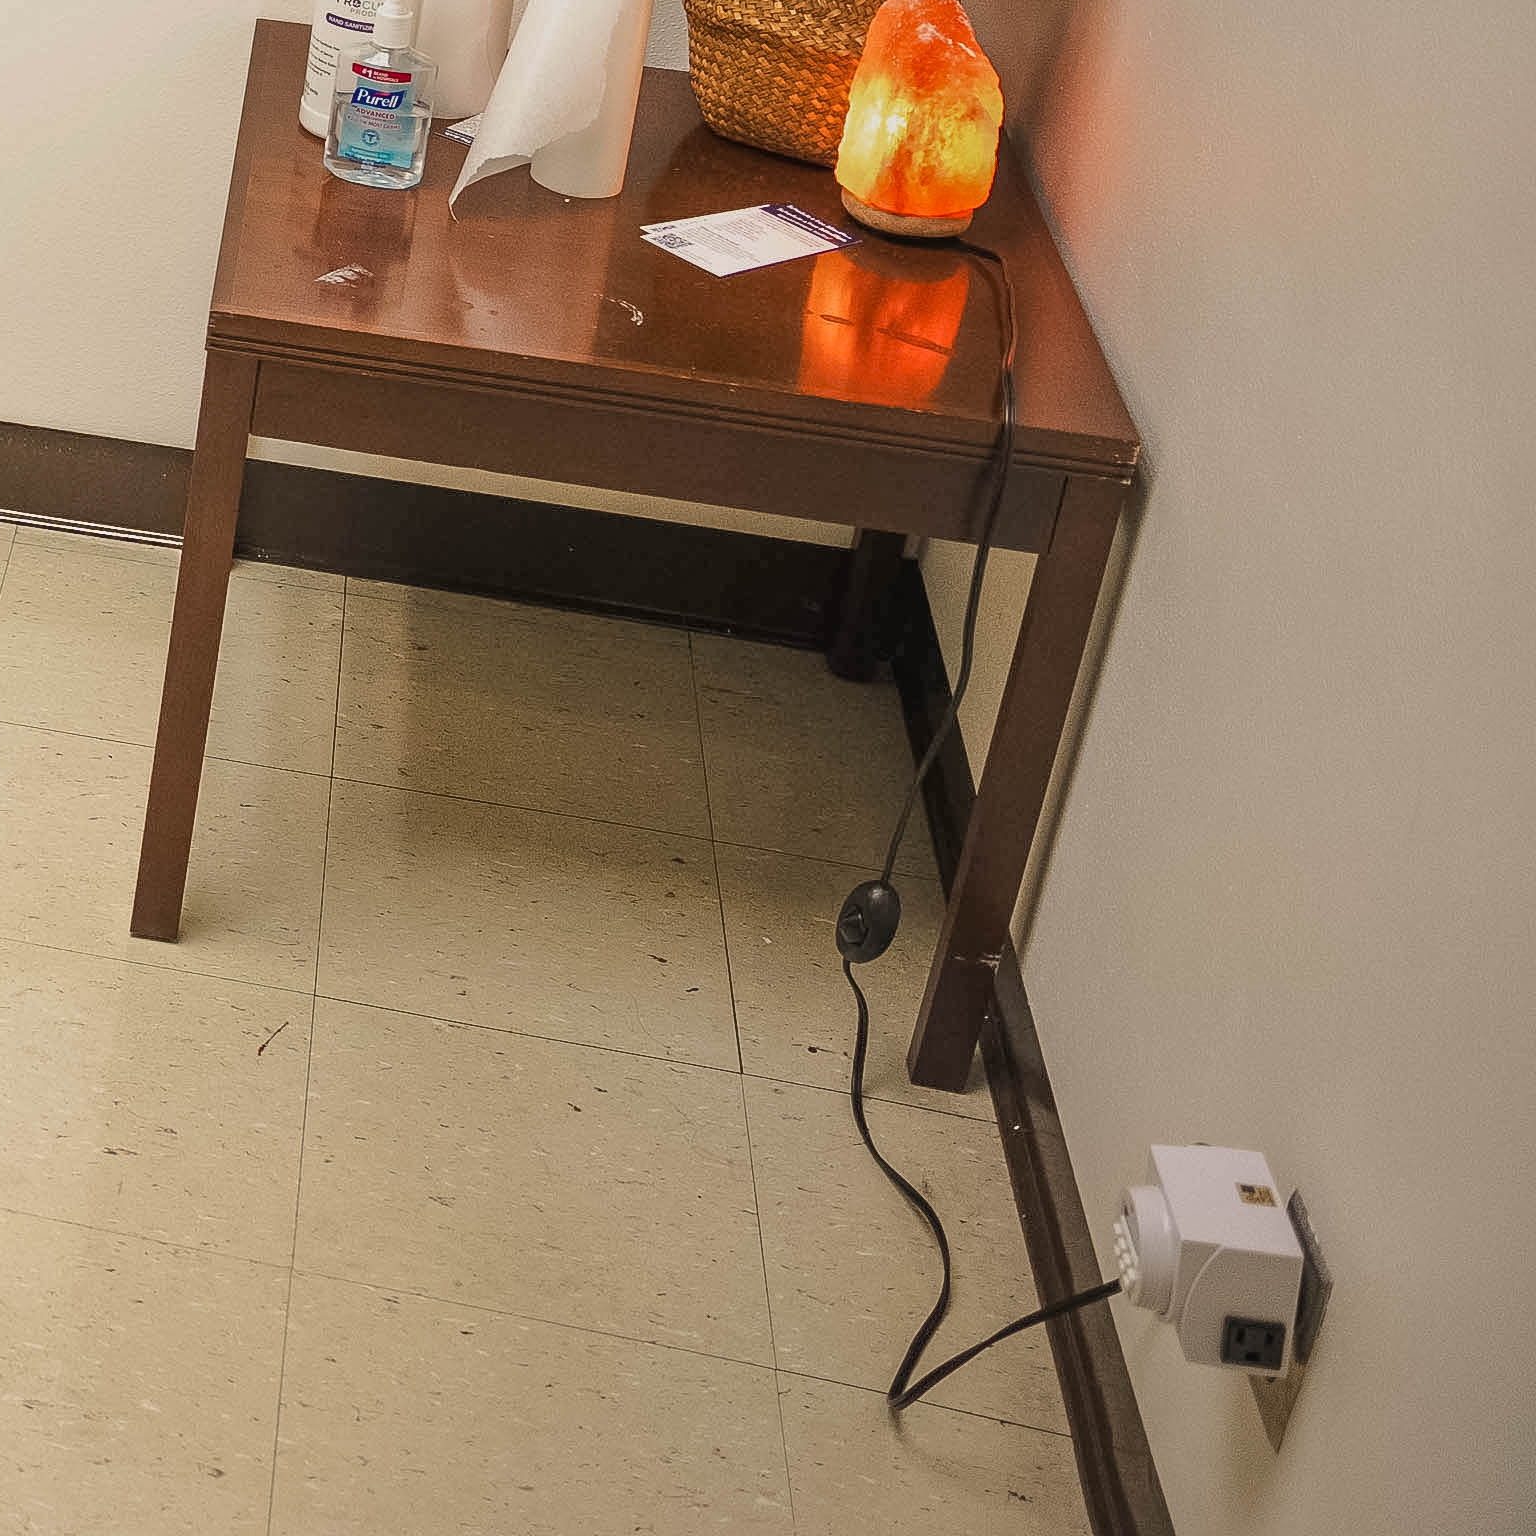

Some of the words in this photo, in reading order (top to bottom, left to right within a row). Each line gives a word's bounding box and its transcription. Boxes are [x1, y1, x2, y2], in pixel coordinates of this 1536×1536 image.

[350, 8, 377, 18] PROD
[328, 16, 344, 25] HAND
[361, 68, 373, 78] #1
[357, 88, 399, 108] Purell
[355, 107, 395, 120] ADVANCED
